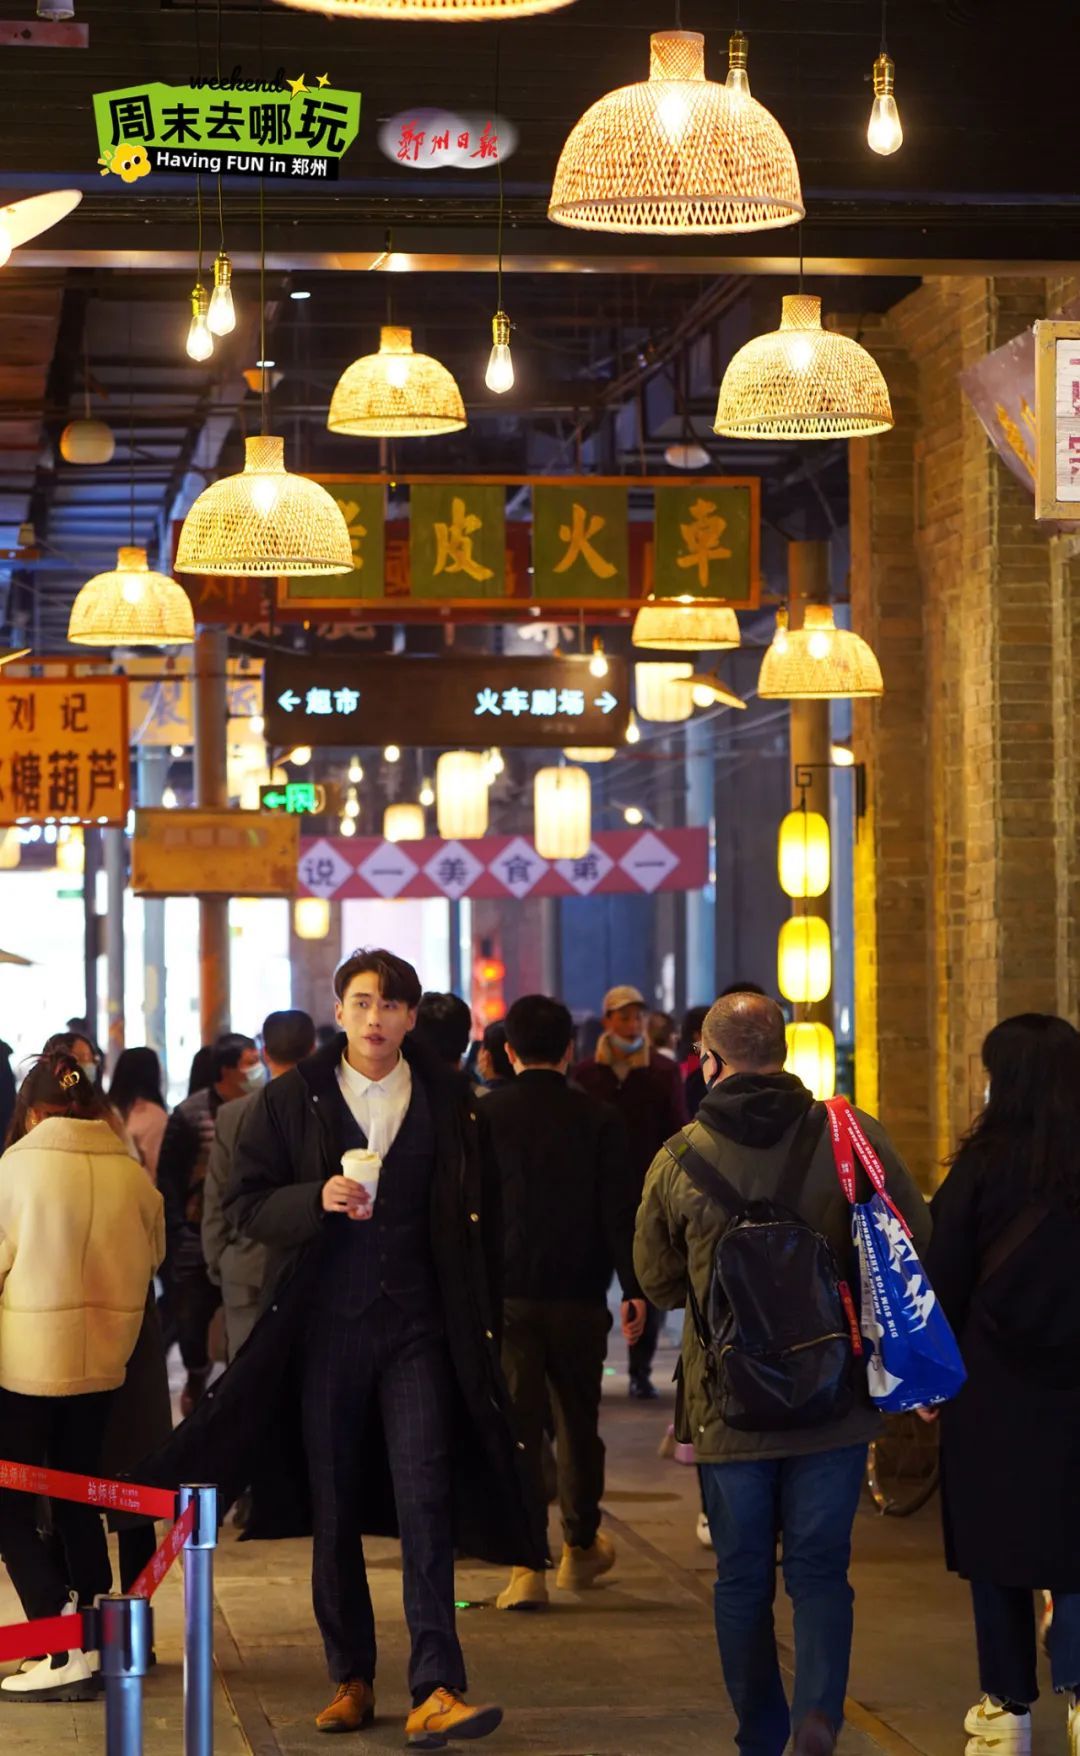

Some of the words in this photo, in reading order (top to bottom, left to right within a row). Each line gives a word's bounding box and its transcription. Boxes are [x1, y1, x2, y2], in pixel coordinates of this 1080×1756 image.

[8, 692, 88, 733] 刘记
[0, 750, 117, 813] 糖葫芦
[880, 1296, 892, 1317] SUM
[887, 1319, 898, 1338] DIM
